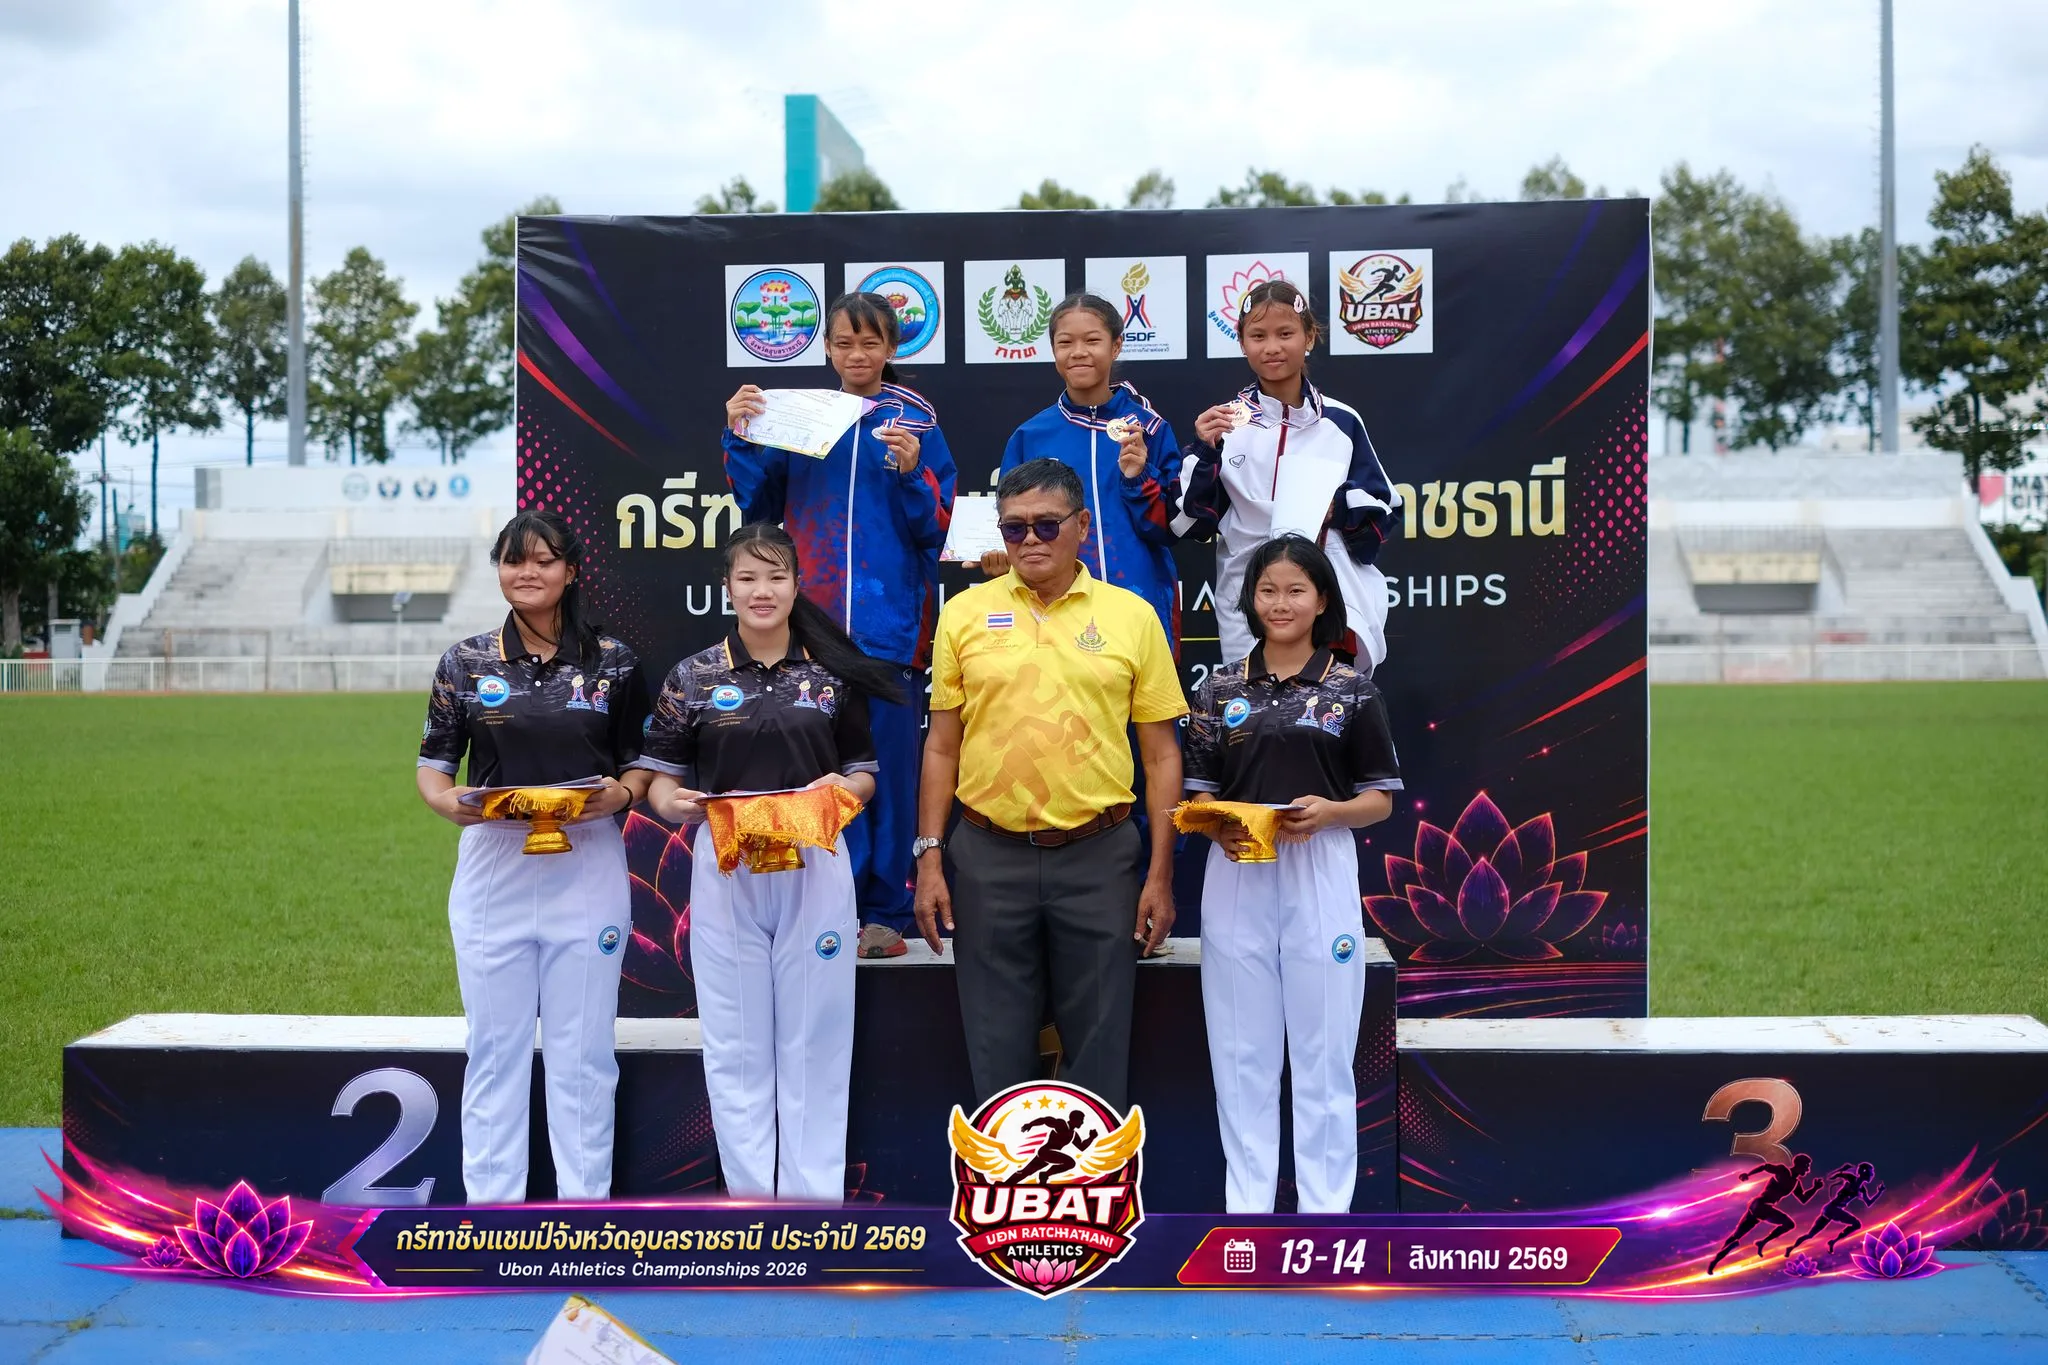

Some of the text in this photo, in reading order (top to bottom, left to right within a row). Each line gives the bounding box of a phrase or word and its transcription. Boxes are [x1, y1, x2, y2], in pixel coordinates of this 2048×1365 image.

[1346, 303, 1416, 321] UBAT
[1123, 332, 1156, 342] SDF
[321, 1067, 439, 1208] 2
